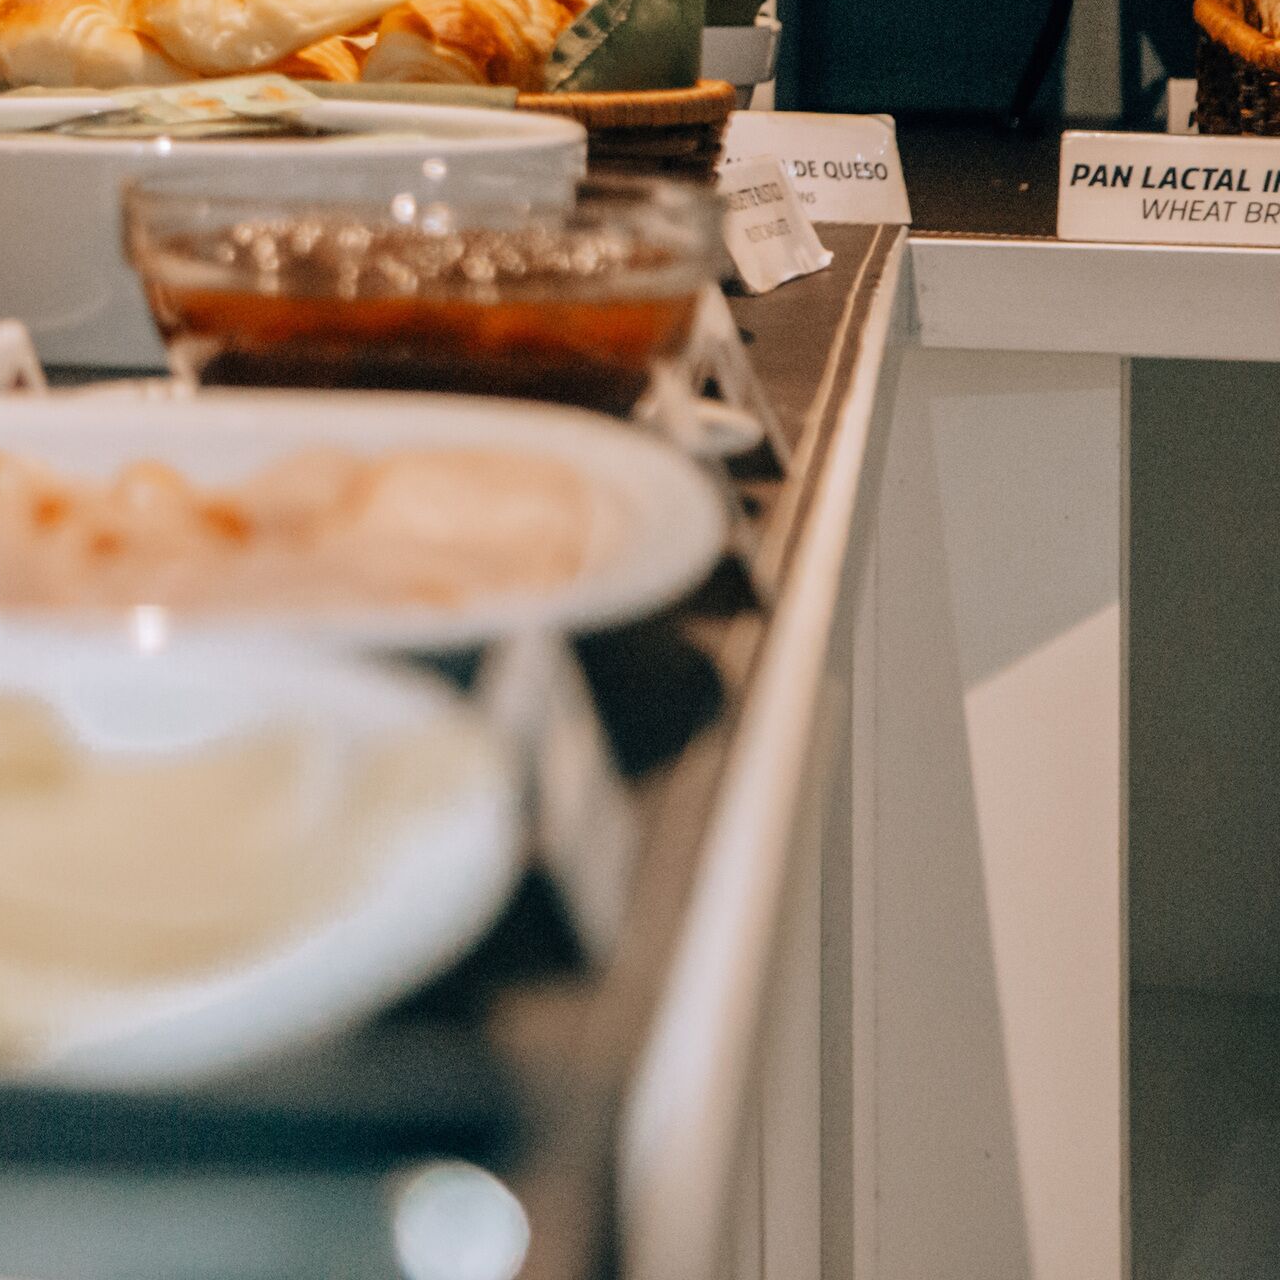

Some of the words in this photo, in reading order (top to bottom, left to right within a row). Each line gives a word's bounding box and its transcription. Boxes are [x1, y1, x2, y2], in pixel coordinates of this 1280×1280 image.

[794, 160, 819, 178] DE
[824, 160, 888, 181] QUESO
[1070, 164, 1133, 187] PAN
[1141, 166, 1251, 192] LACTAL
[1142, 198, 1237, 223] WHEAT
